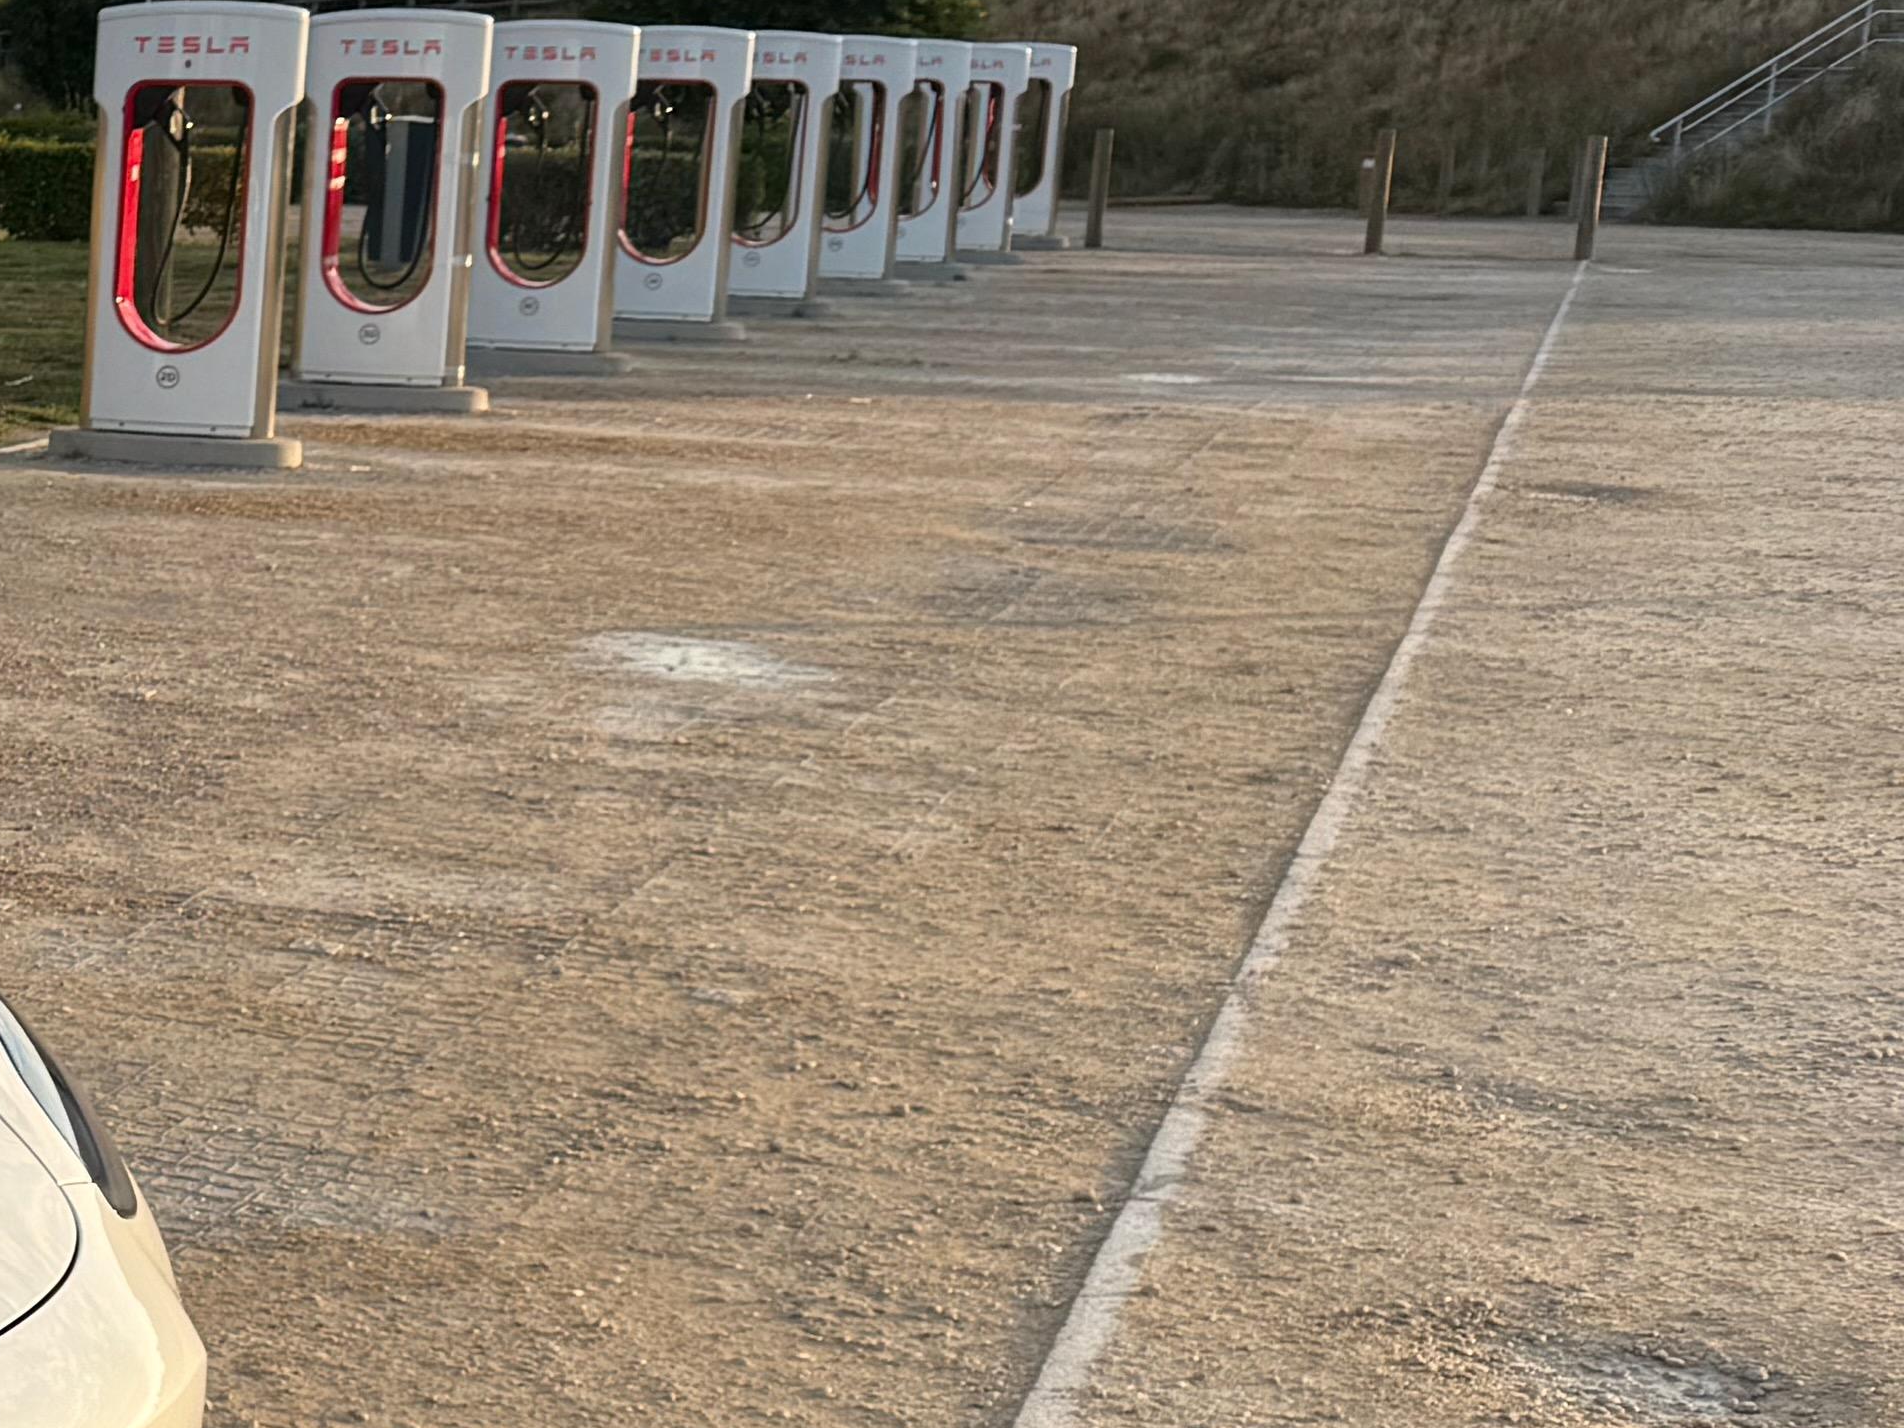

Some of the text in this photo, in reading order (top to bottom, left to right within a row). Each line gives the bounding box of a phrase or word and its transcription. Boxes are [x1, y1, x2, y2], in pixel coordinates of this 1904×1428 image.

[134, 36, 250, 54] TESLA
[340, 39, 442, 56] TESLA
[504, 45, 597, 61] TESLA
[640, 48, 717, 62] ESLA
